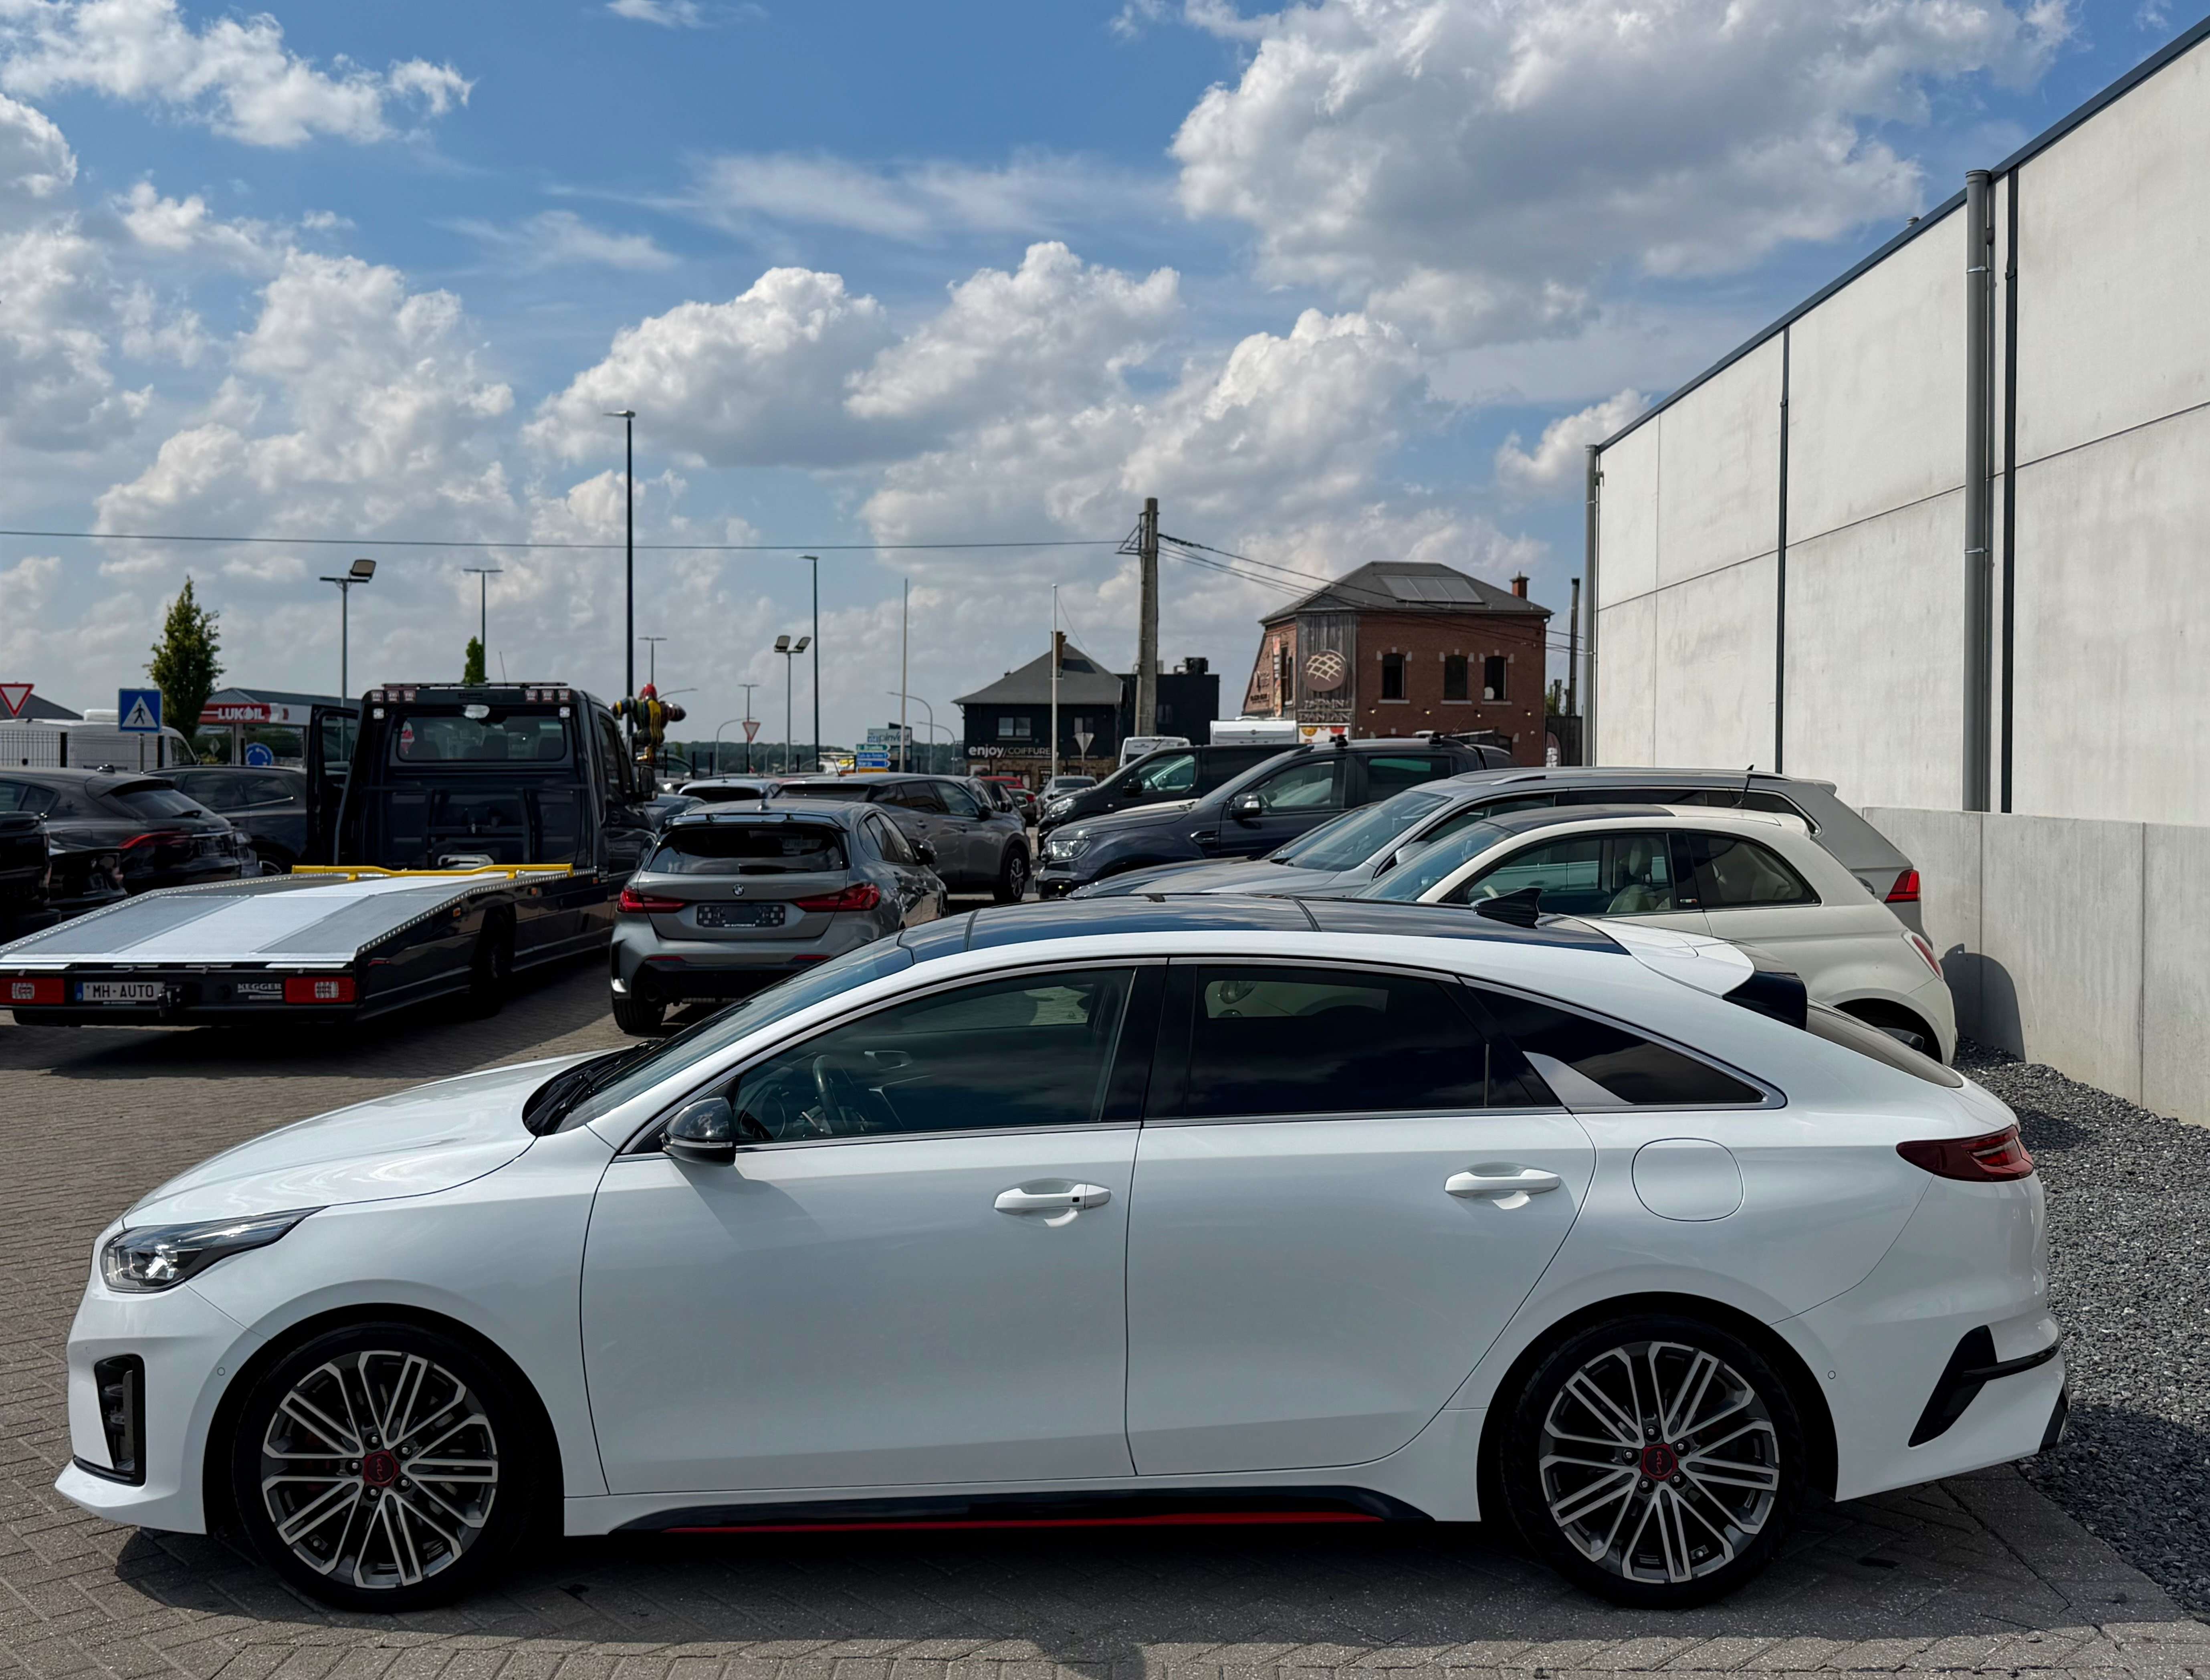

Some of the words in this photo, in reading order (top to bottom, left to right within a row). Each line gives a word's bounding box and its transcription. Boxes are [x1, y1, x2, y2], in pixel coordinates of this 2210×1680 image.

[218, 706, 264, 720] LUKOIL
[968, 744, 1003, 758] enjoy
[1007, 747, 1051, 755] COIFFURE
